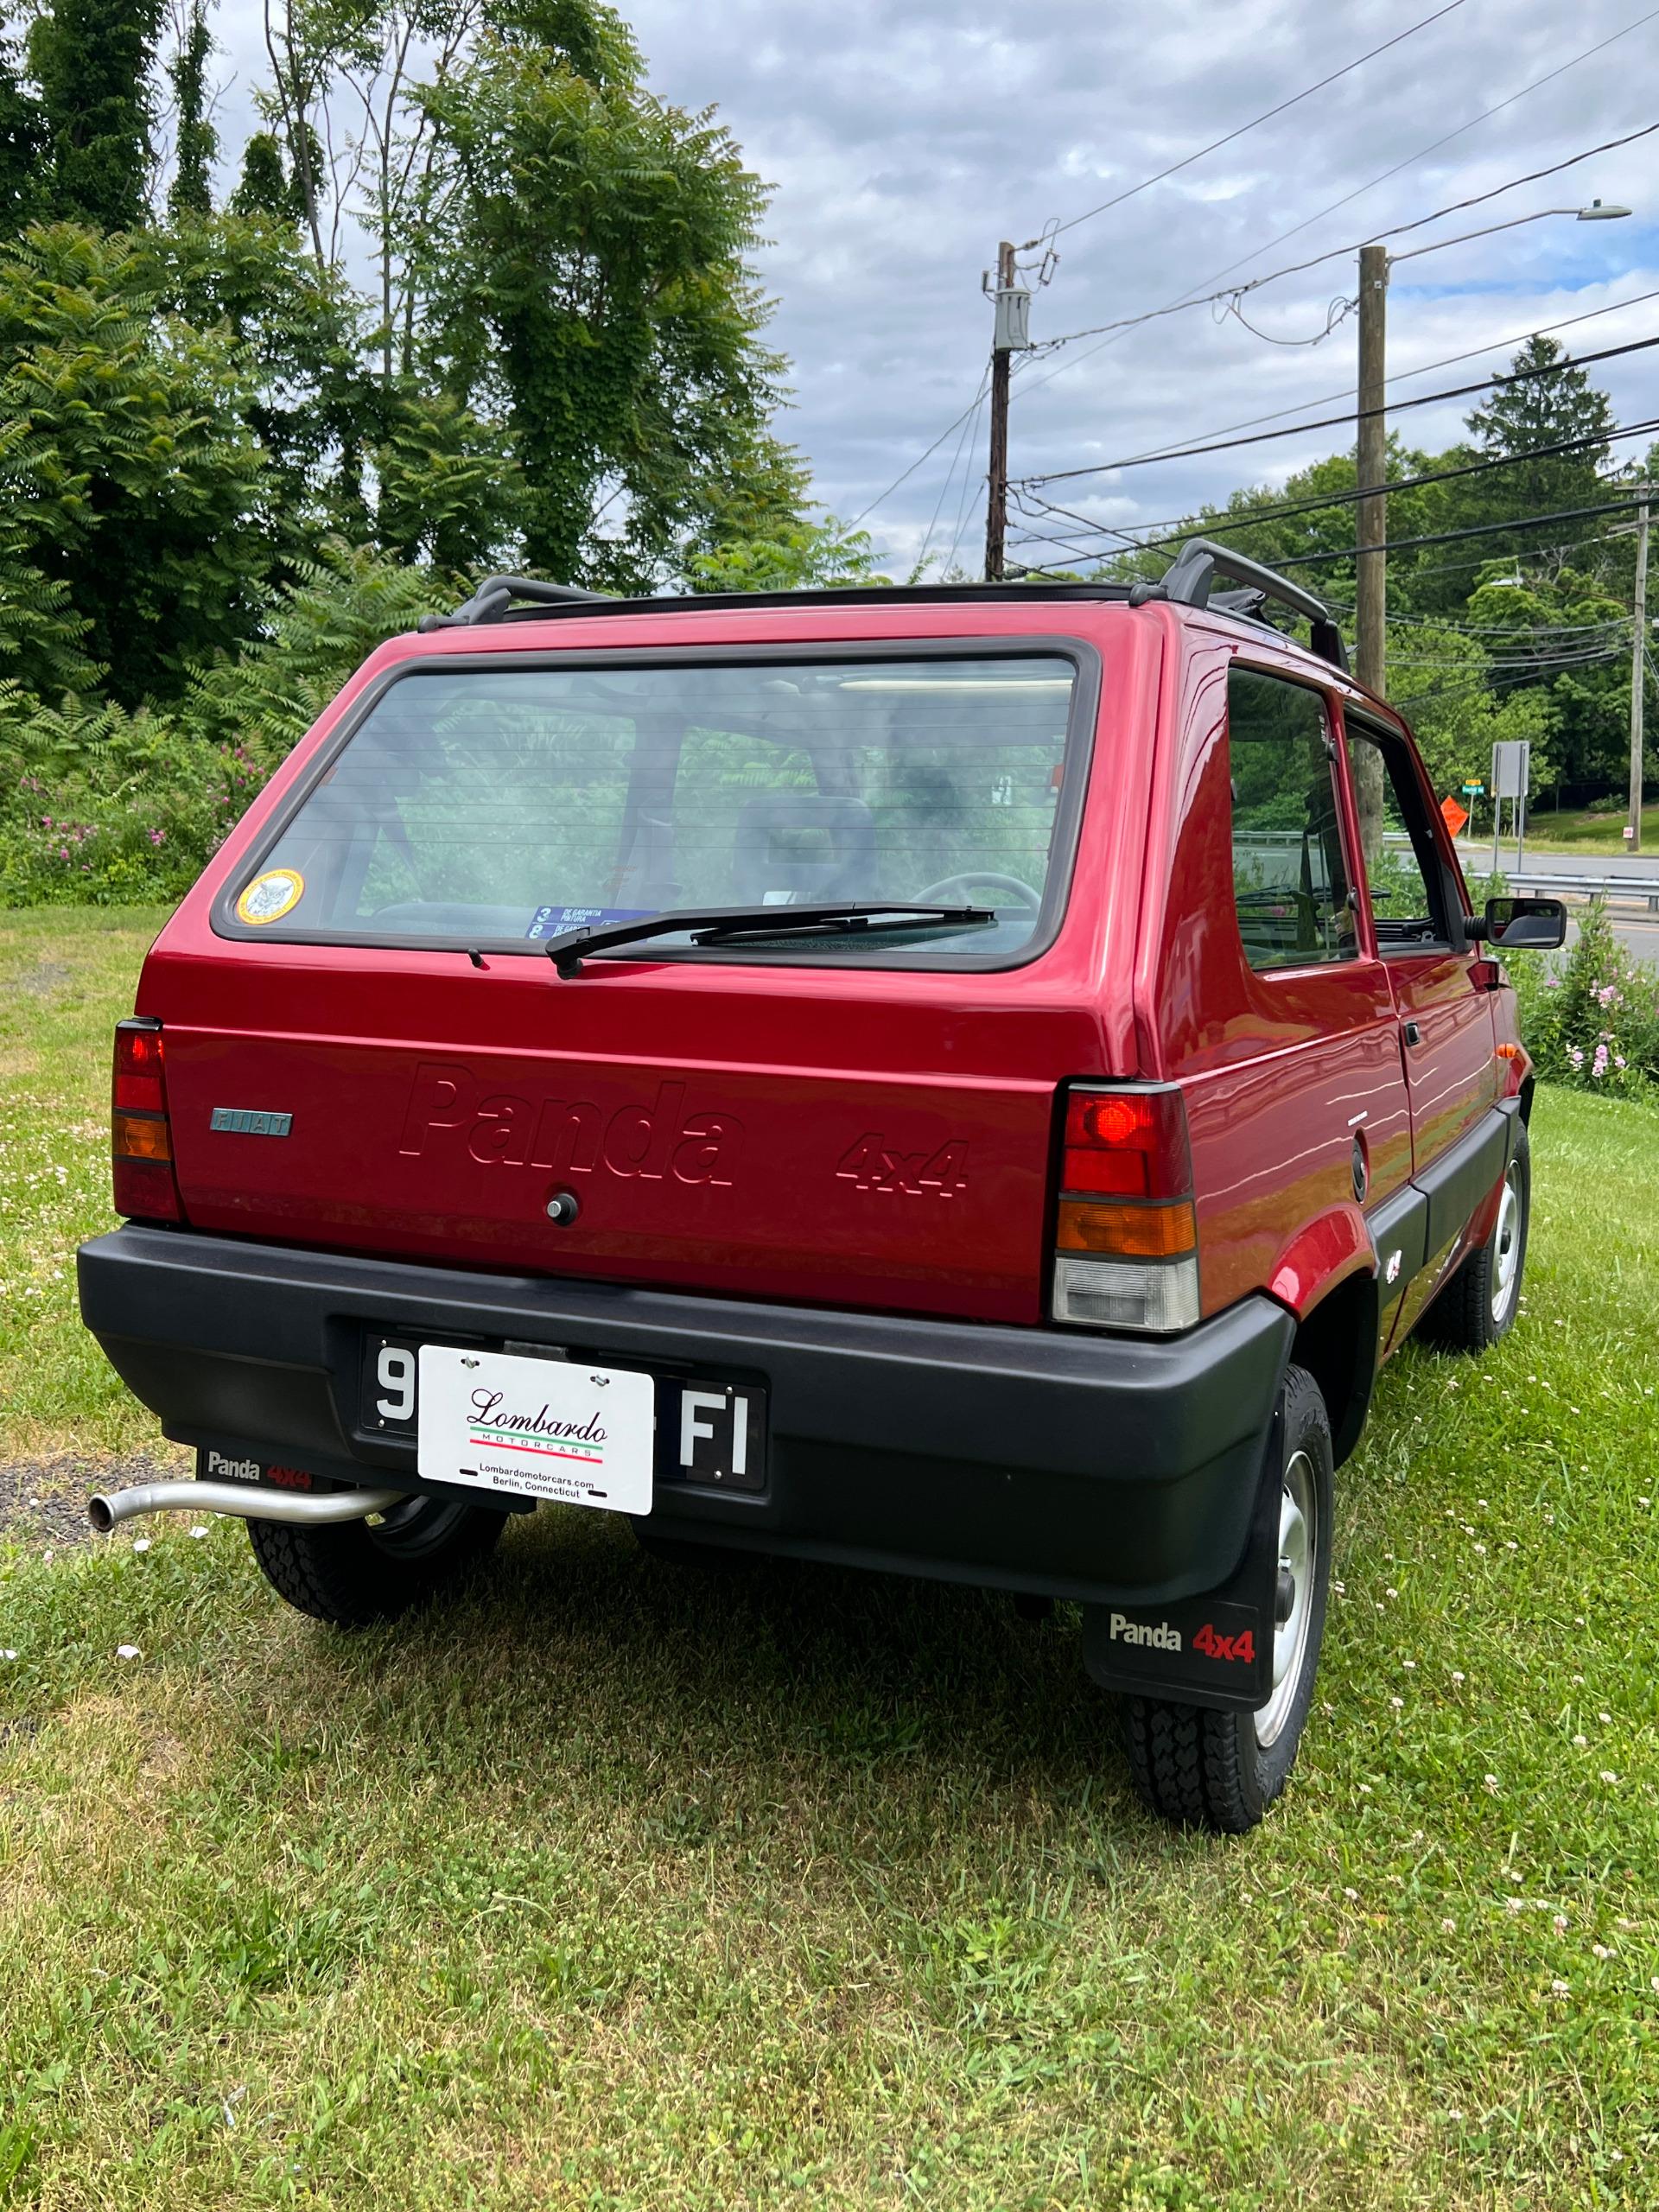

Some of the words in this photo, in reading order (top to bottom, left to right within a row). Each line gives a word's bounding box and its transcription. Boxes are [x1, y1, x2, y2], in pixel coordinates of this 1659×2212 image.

[537, 908, 551, 922] 3
[529, 925, 543, 938] 8
[214, 1110, 288, 1135] FIAT
[399, 1061, 746, 1185] Panda
[836, 1132, 969, 1198] 4x4
[376, 1346, 415, 1421] 9
[467, 1389, 608, 1443] Lombardo
[482, 1433, 591, 1457] MOTORCARS
[207, 1451, 260, 1481] Panda
[267, 1465, 313, 1490] 4x4
[480, 1463, 594, 1490] Lombardomotorcars.com
[493, 1476, 523, 1490] Berlin,
[524, 1481, 581, 1498] Connecticut
[1109, 1612, 1182, 1652] Panda
[1192, 1624, 1255, 1664] 4x4
